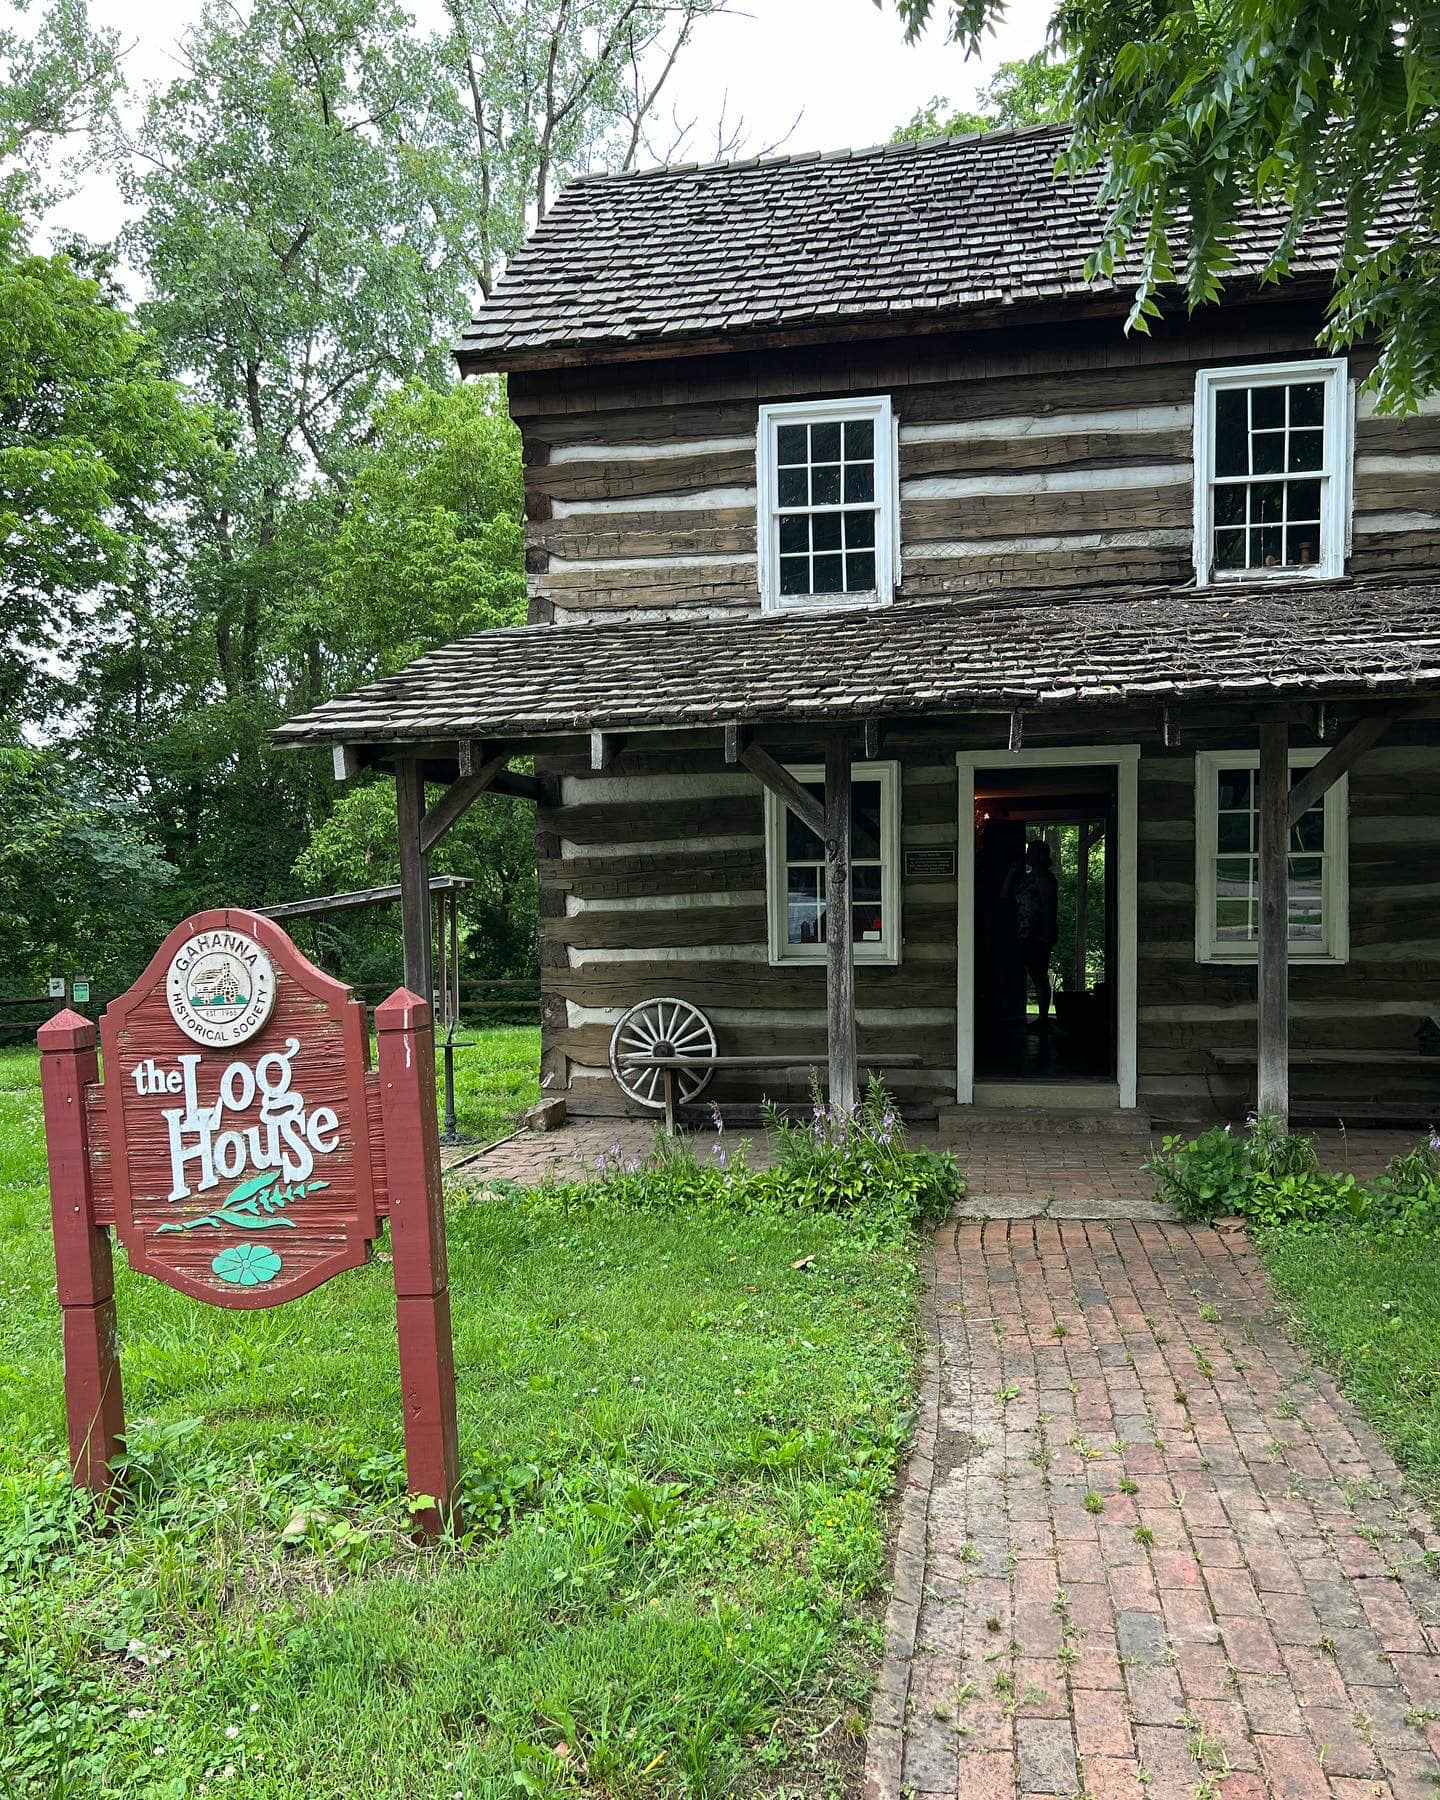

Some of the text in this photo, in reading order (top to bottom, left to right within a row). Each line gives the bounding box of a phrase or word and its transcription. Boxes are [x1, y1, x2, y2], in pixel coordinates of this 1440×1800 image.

[175, 934, 258, 971] GAHANNA
[172, 988, 268, 1041] HISTORICAL SOCIETY
[131, 1038, 305, 1131] the Log
[161, 1106, 340, 1203] House
